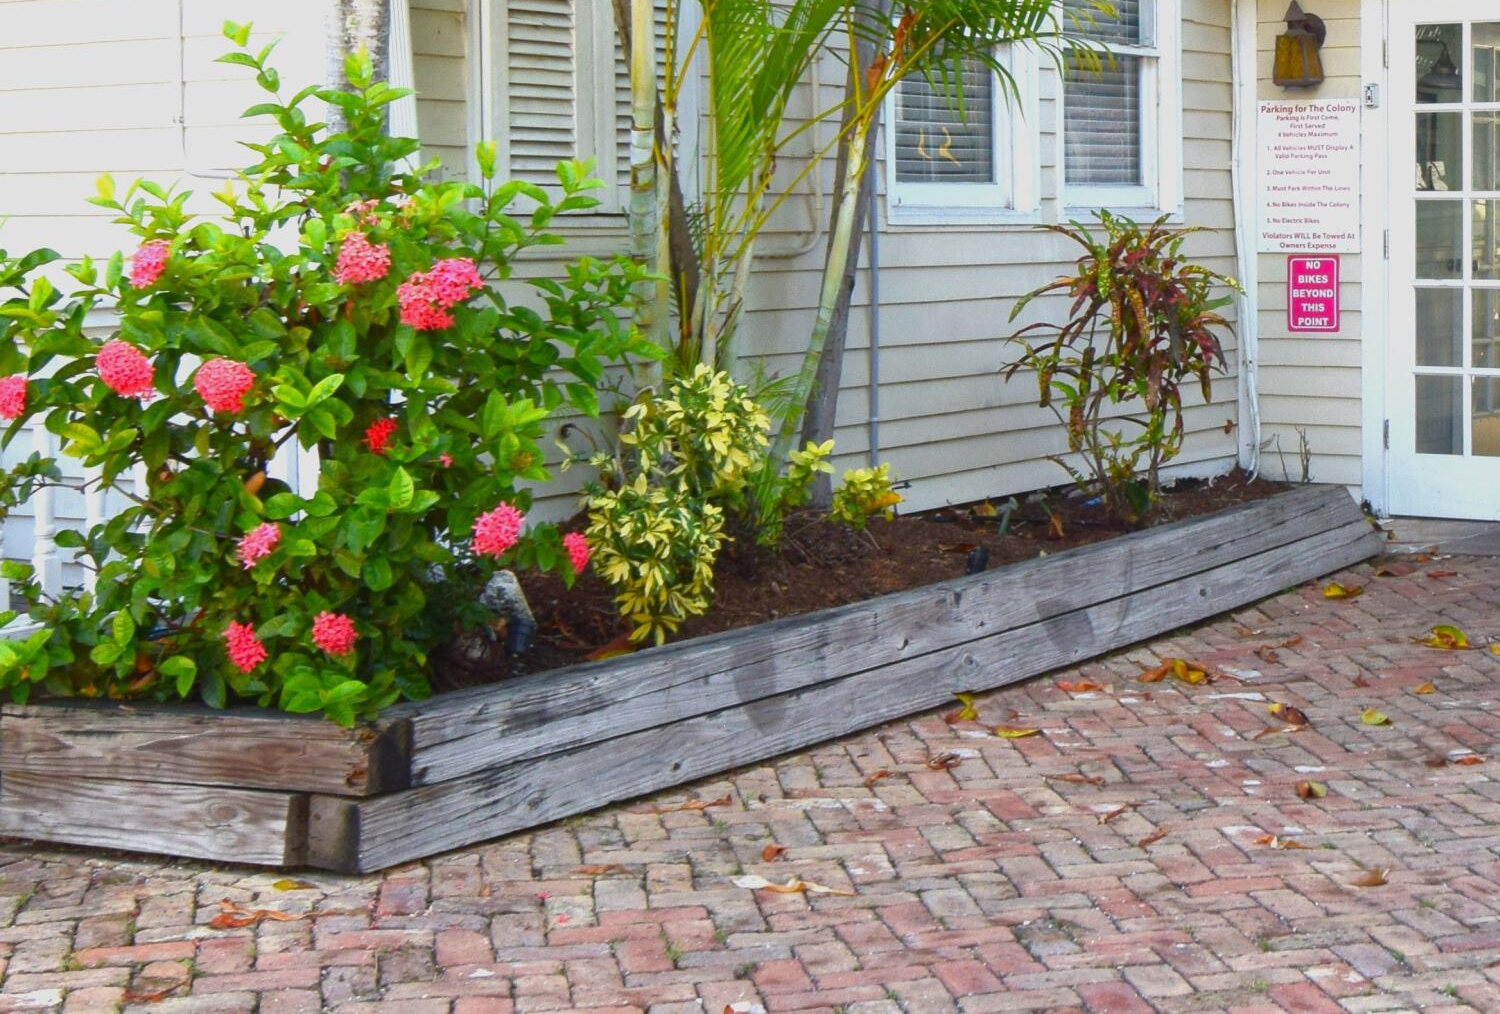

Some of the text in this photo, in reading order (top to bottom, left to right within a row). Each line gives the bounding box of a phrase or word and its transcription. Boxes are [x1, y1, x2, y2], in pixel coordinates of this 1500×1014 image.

[1261, 105, 1292, 114] Parking
[1326, 104, 1356, 114] Colony
[1307, 242, 1336, 250] Expense
[1306, 261, 1321, 269] NO
[1298, 275, 1328, 283] BIKES
[1292, 289, 1334, 298] BEYOND
[1301, 303, 1325, 312] THIS
[1298, 317, 1328, 326] POINT
